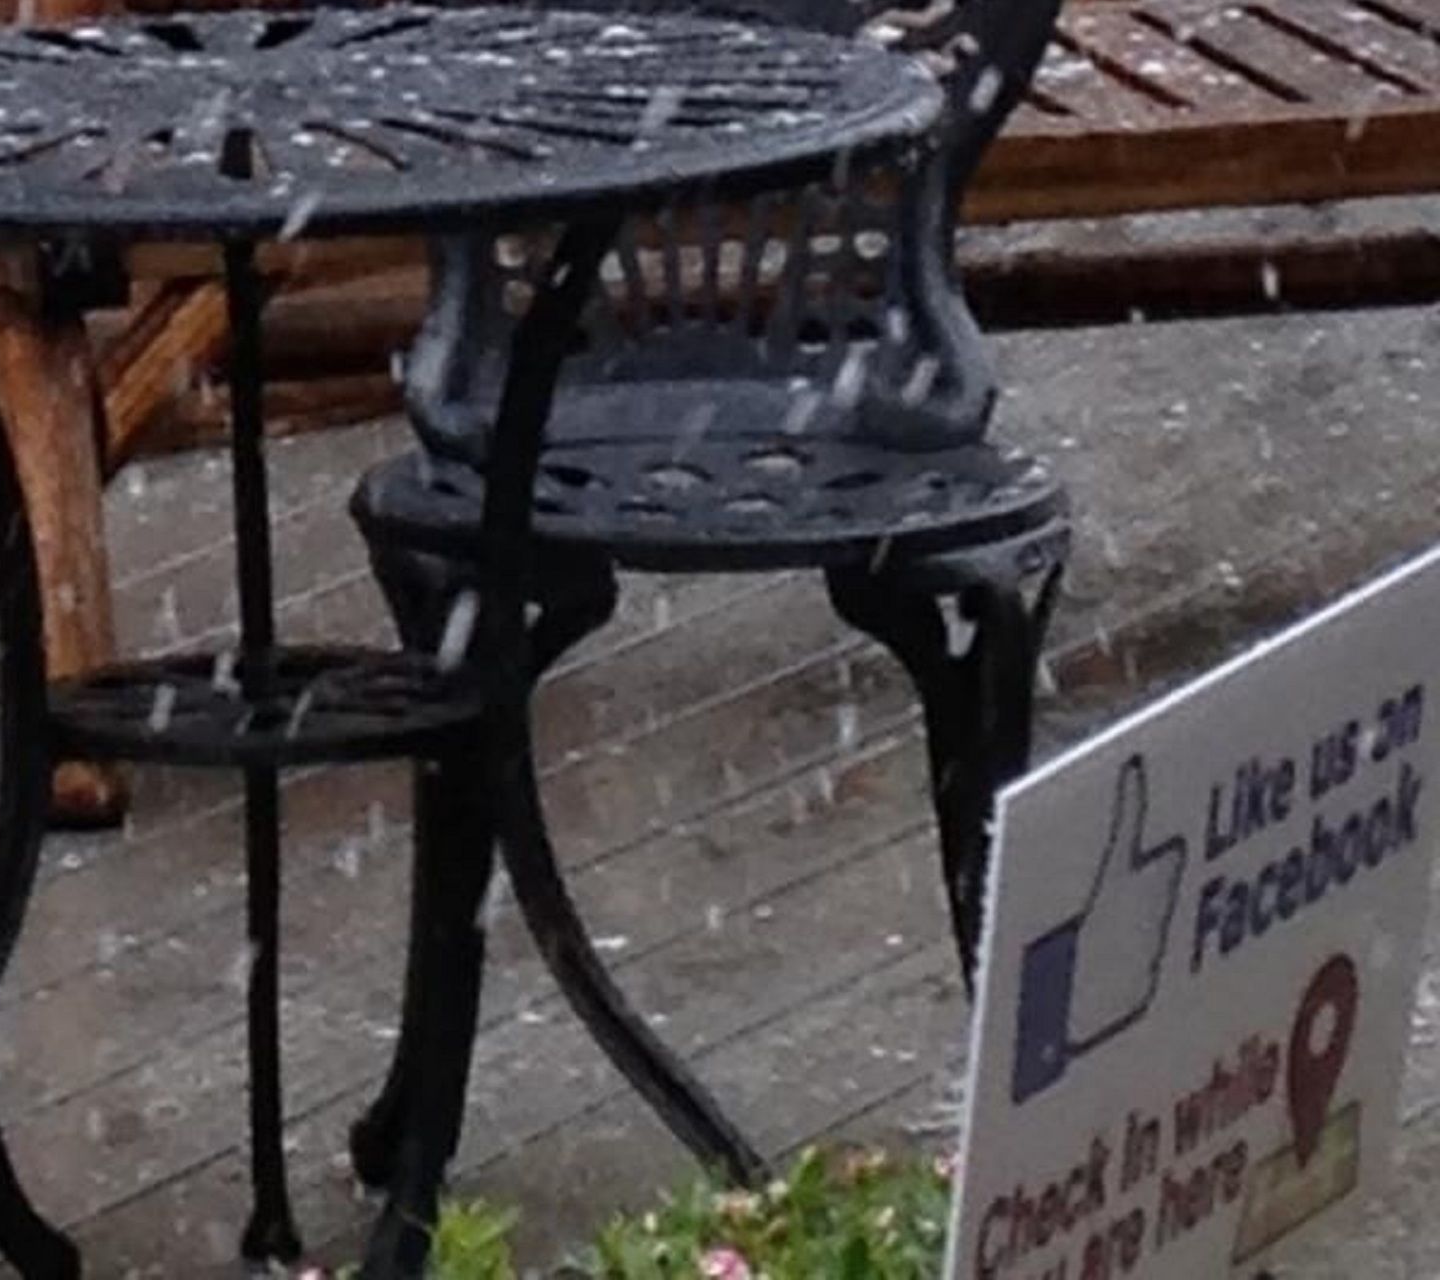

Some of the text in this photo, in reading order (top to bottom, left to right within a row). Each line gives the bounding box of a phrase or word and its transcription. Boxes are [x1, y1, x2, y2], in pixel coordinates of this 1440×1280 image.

[1190, 761, 1422, 974] Facebook
[1204, 754, 1297, 863] Like
[1309, 719, 1360, 801] us
[973, 1135, 1110, 1280] Check
[1172, 1032, 1280, 1156] while
[1156, 1139, 1250, 1248] here
